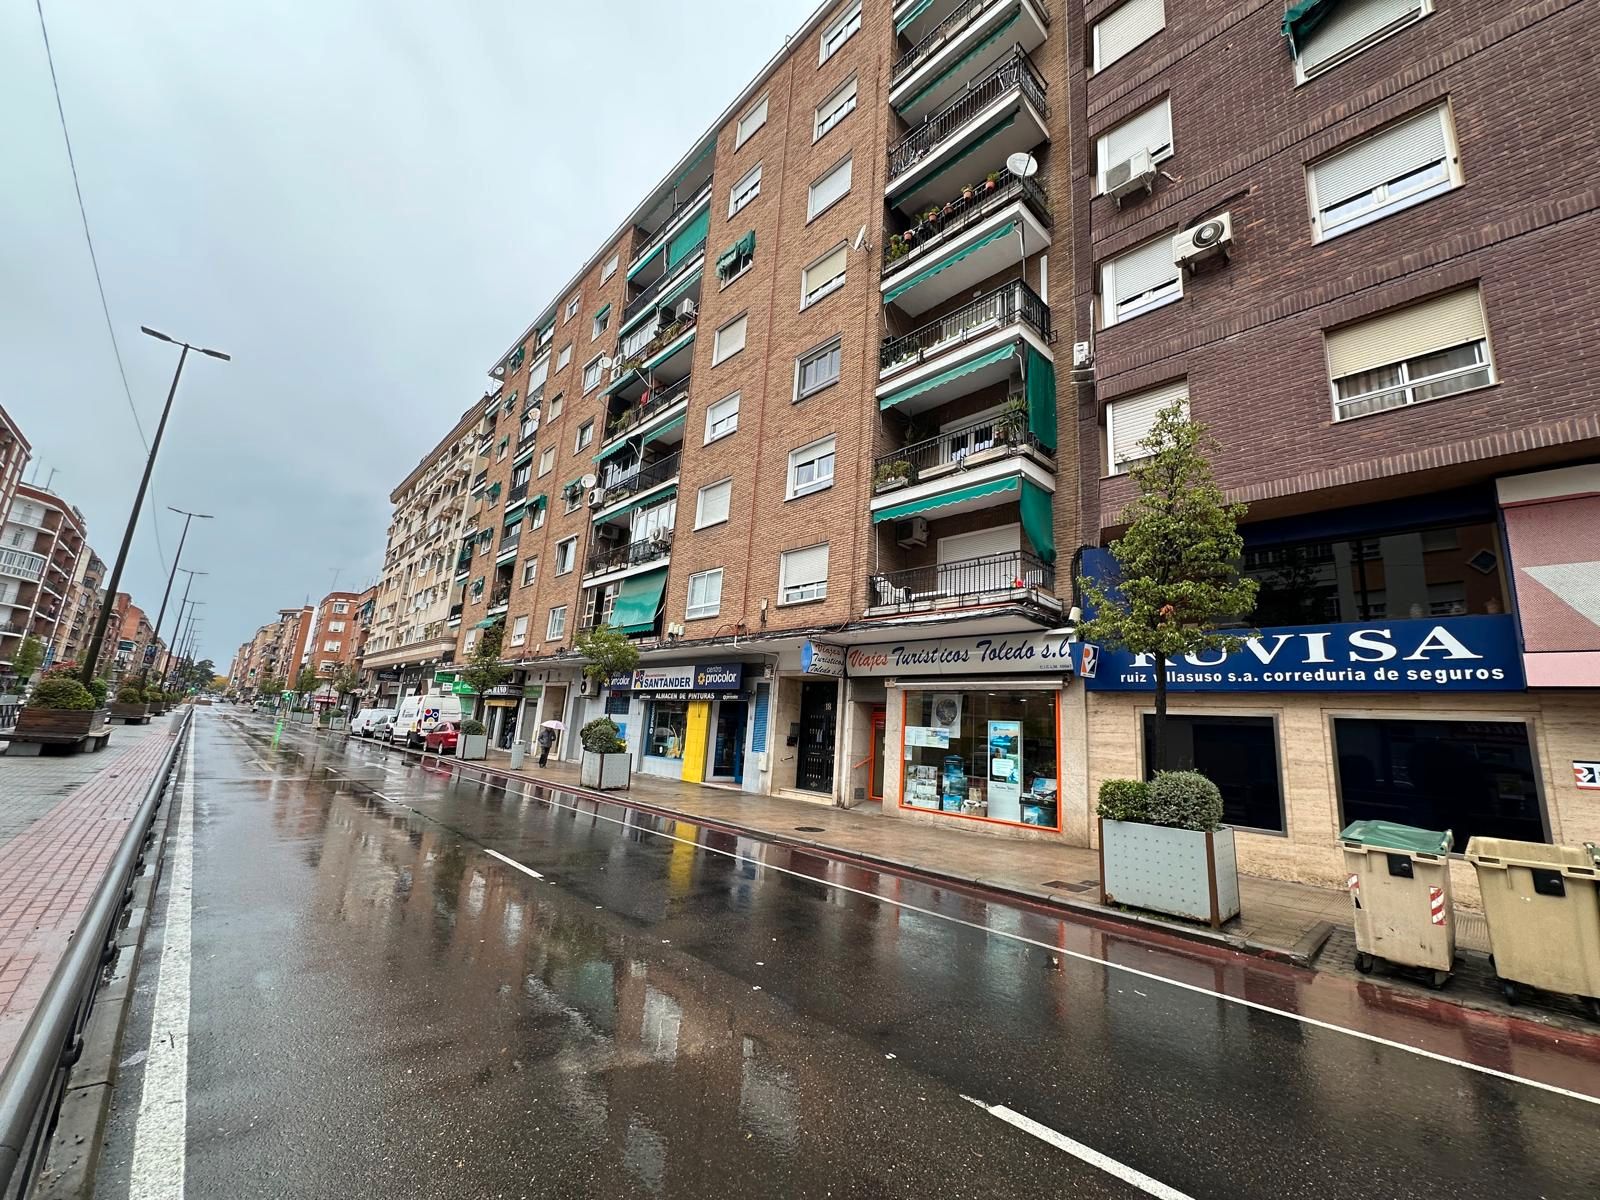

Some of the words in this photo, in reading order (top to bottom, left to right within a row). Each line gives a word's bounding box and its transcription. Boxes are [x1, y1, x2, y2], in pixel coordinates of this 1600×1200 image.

[815, 644, 841, 657] Viajes
[848, 649, 889, 672] Viajes
[891, 646, 969, 667] Turisticos
[976, 639, 1036, 662] Toledo
[706, 666, 722, 674] centro
[810, 663, 831, 674] Toledo
[705, 670, 737, 686] procolor
[1120, 671, 1147, 683] ruiz
[1154, 671, 1223, 682] llasuso
[1228, 671, 1258, 682] s.a.
[1263, 668, 1366, 682] correduria
[1374, 667, 1400, 681] de
[1407, 668, 1505, 684] seguros
[643, 676, 691, 688] SANTANDER
[655, 692, 678, 700] ALMACEN
[679, 692, 687, 700] DE
[688, 692, 715, 700] PINTURAS
[825, 702, 832, 711] 18
